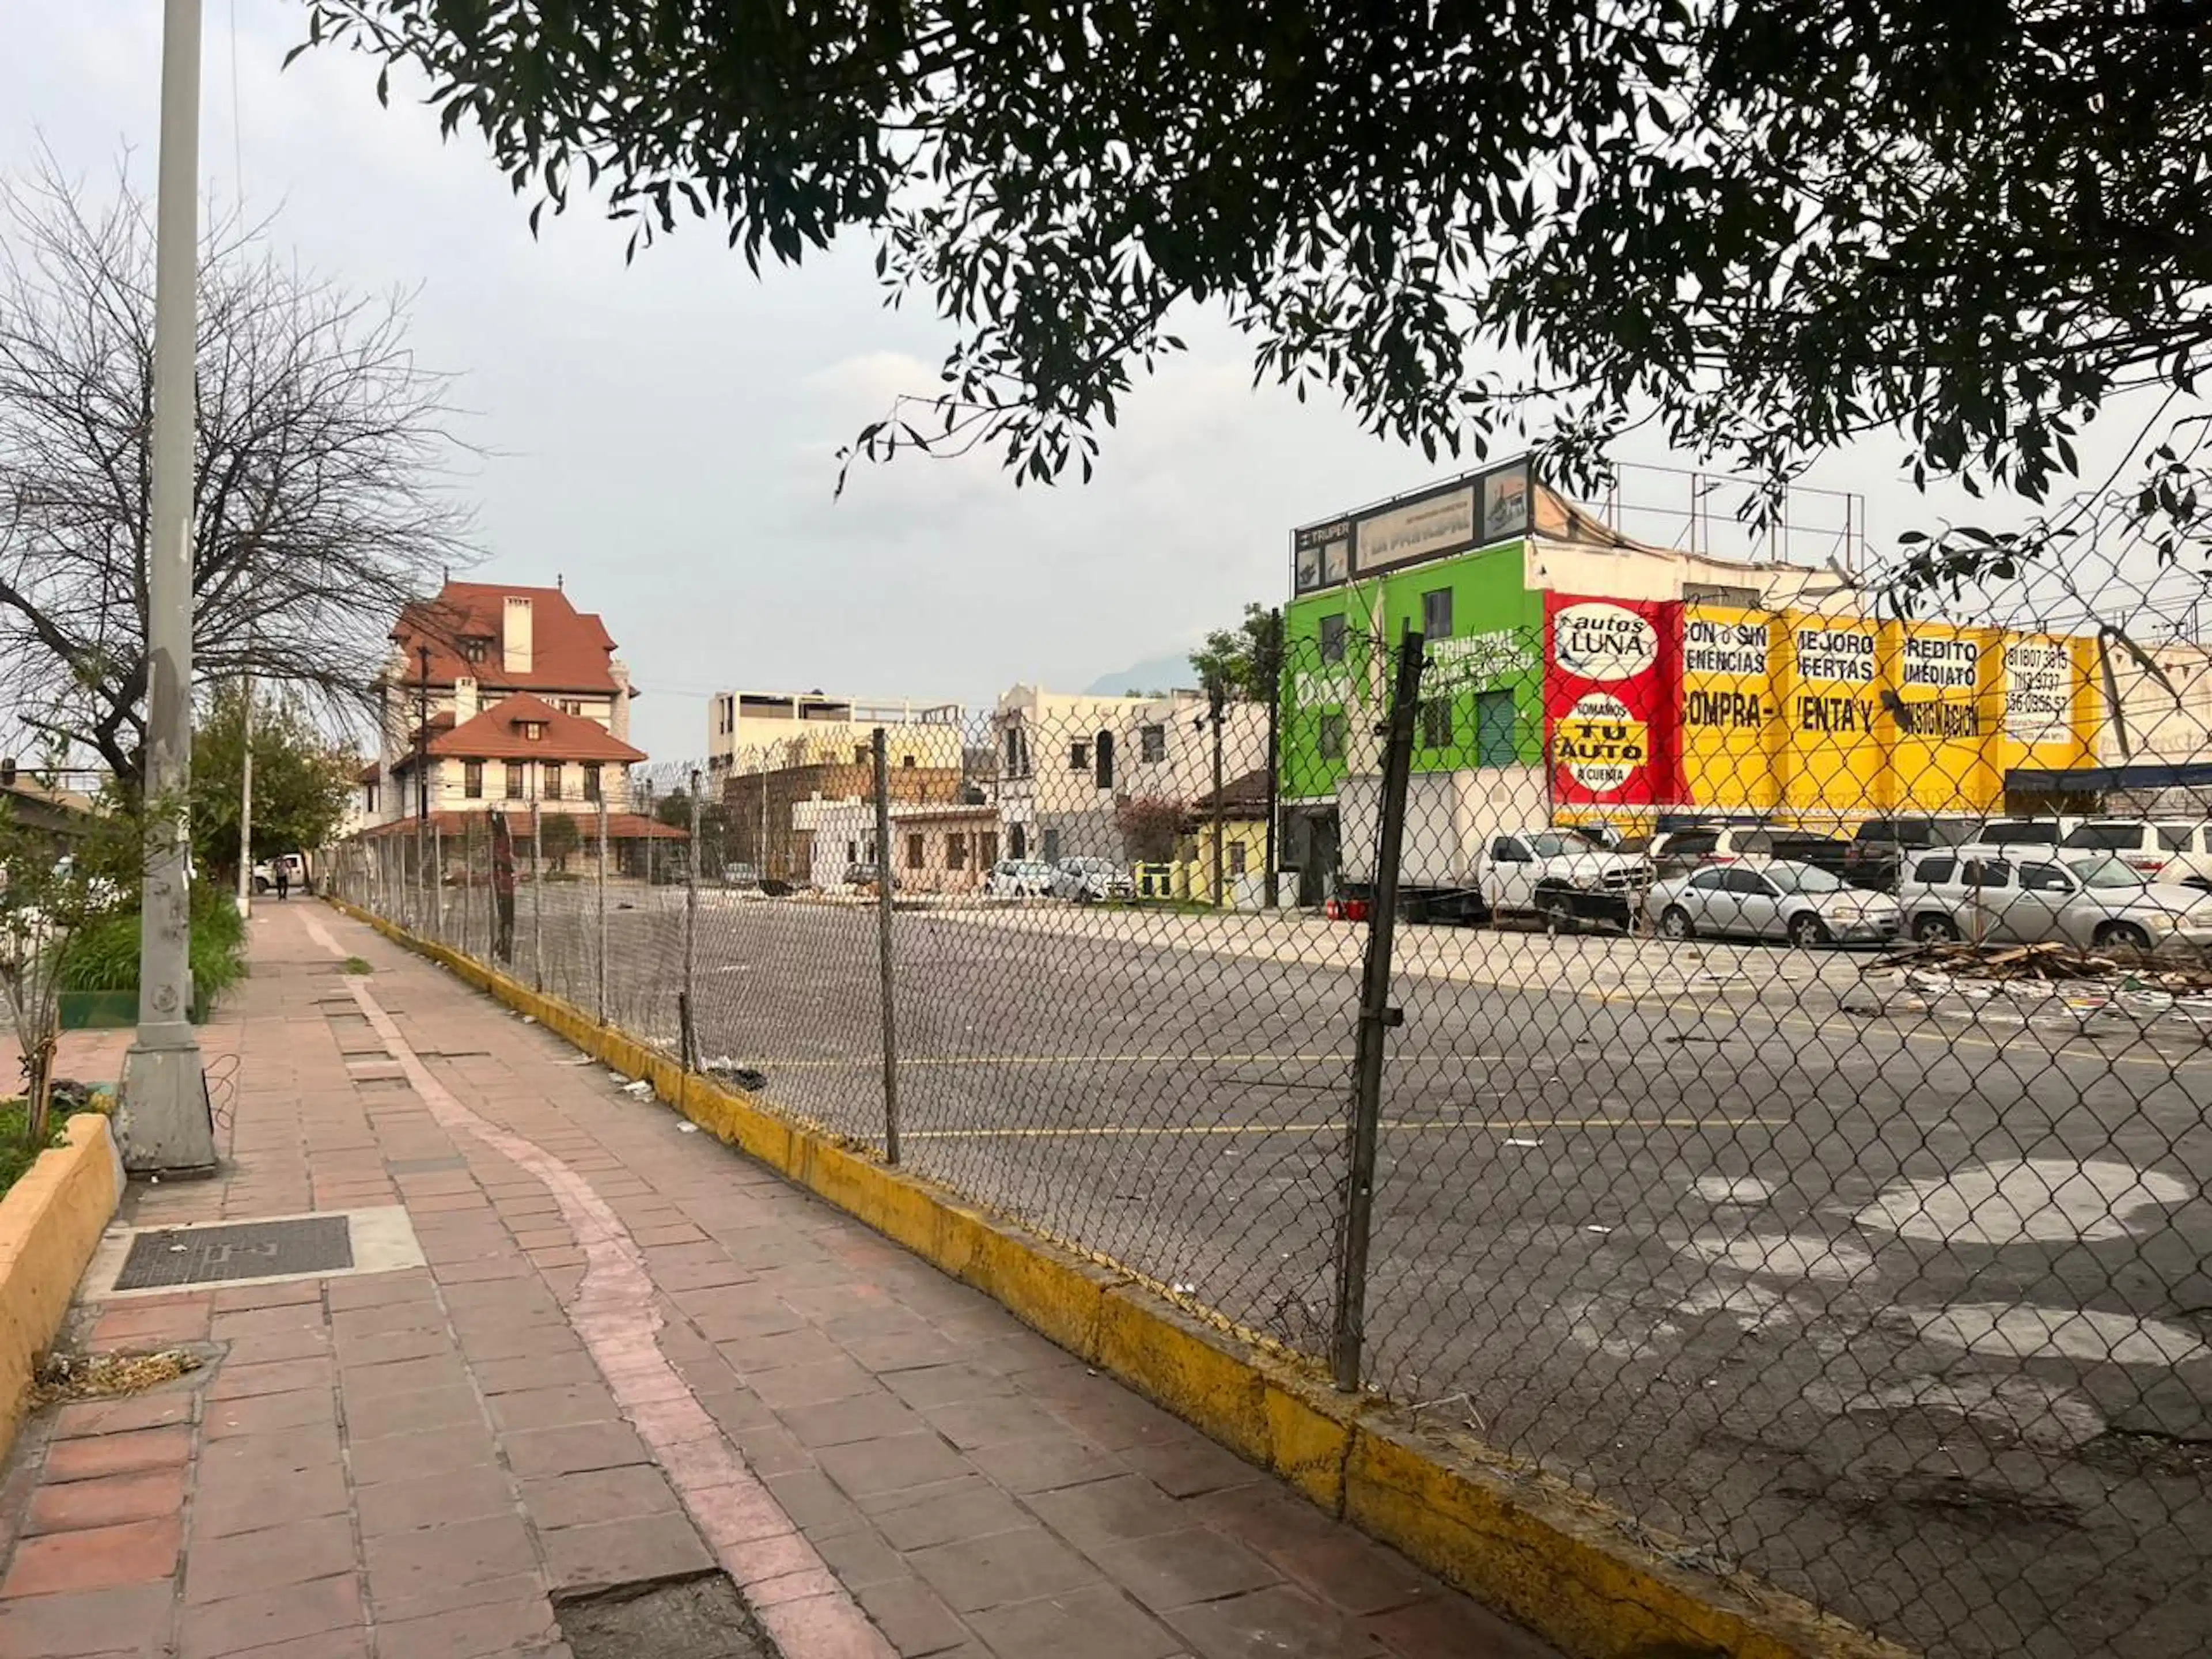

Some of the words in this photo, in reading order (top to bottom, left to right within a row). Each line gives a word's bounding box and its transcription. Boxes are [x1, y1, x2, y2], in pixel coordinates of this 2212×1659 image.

[1574, 613, 1644, 633] autos
[1573, 632, 1644, 656] LUNA
[1737, 625, 1766, 646] SIN
[1687, 649, 1766, 673] ENENCIAS
[1903, 638, 1977, 662] REDITO
[1798, 657, 1873, 682] FERTAS
[1575, 724, 1627, 740] TU
[1558, 738, 1642, 759] AUTO
